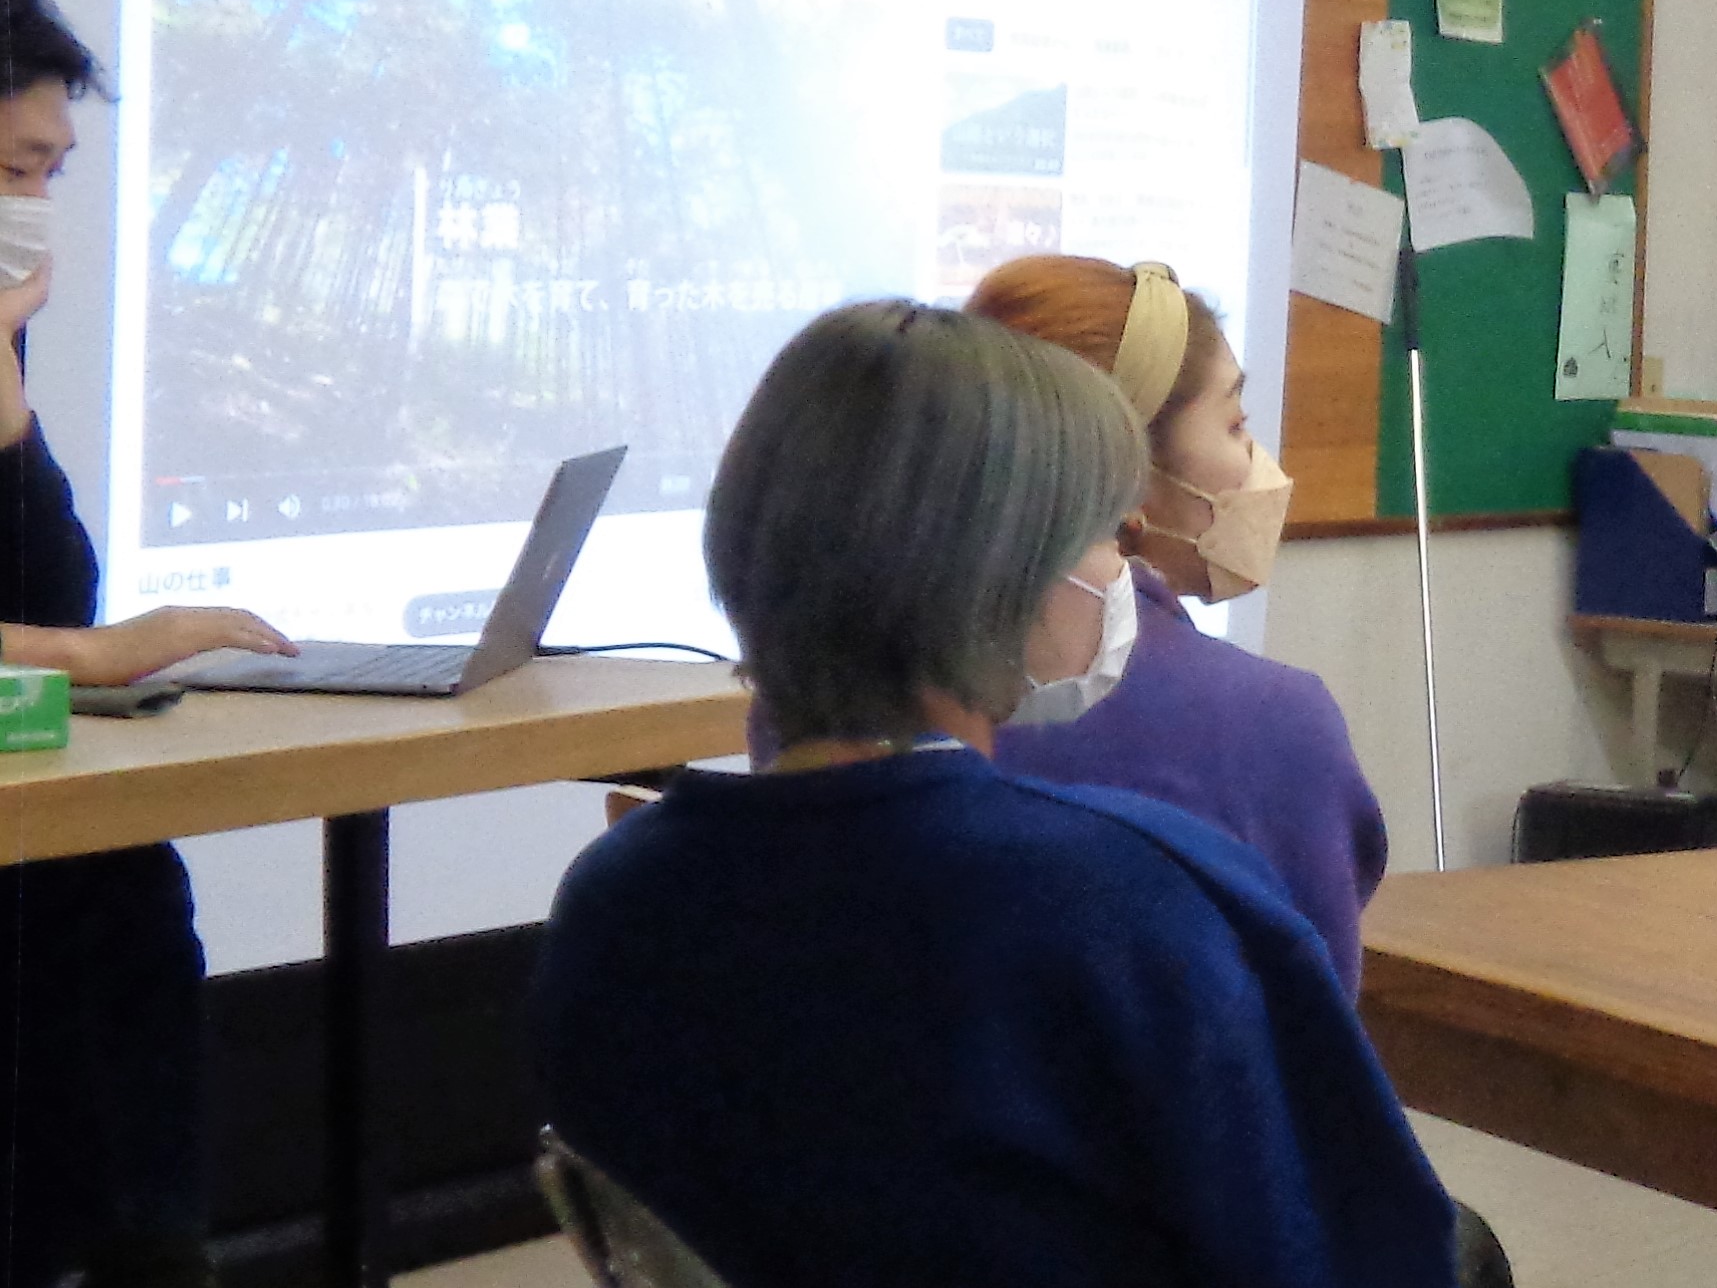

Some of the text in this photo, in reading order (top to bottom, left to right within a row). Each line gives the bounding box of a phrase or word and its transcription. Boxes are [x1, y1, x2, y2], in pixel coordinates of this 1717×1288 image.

[437, 200, 521, 250] 林業
[138, 566, 232, 595] 山の仕事
